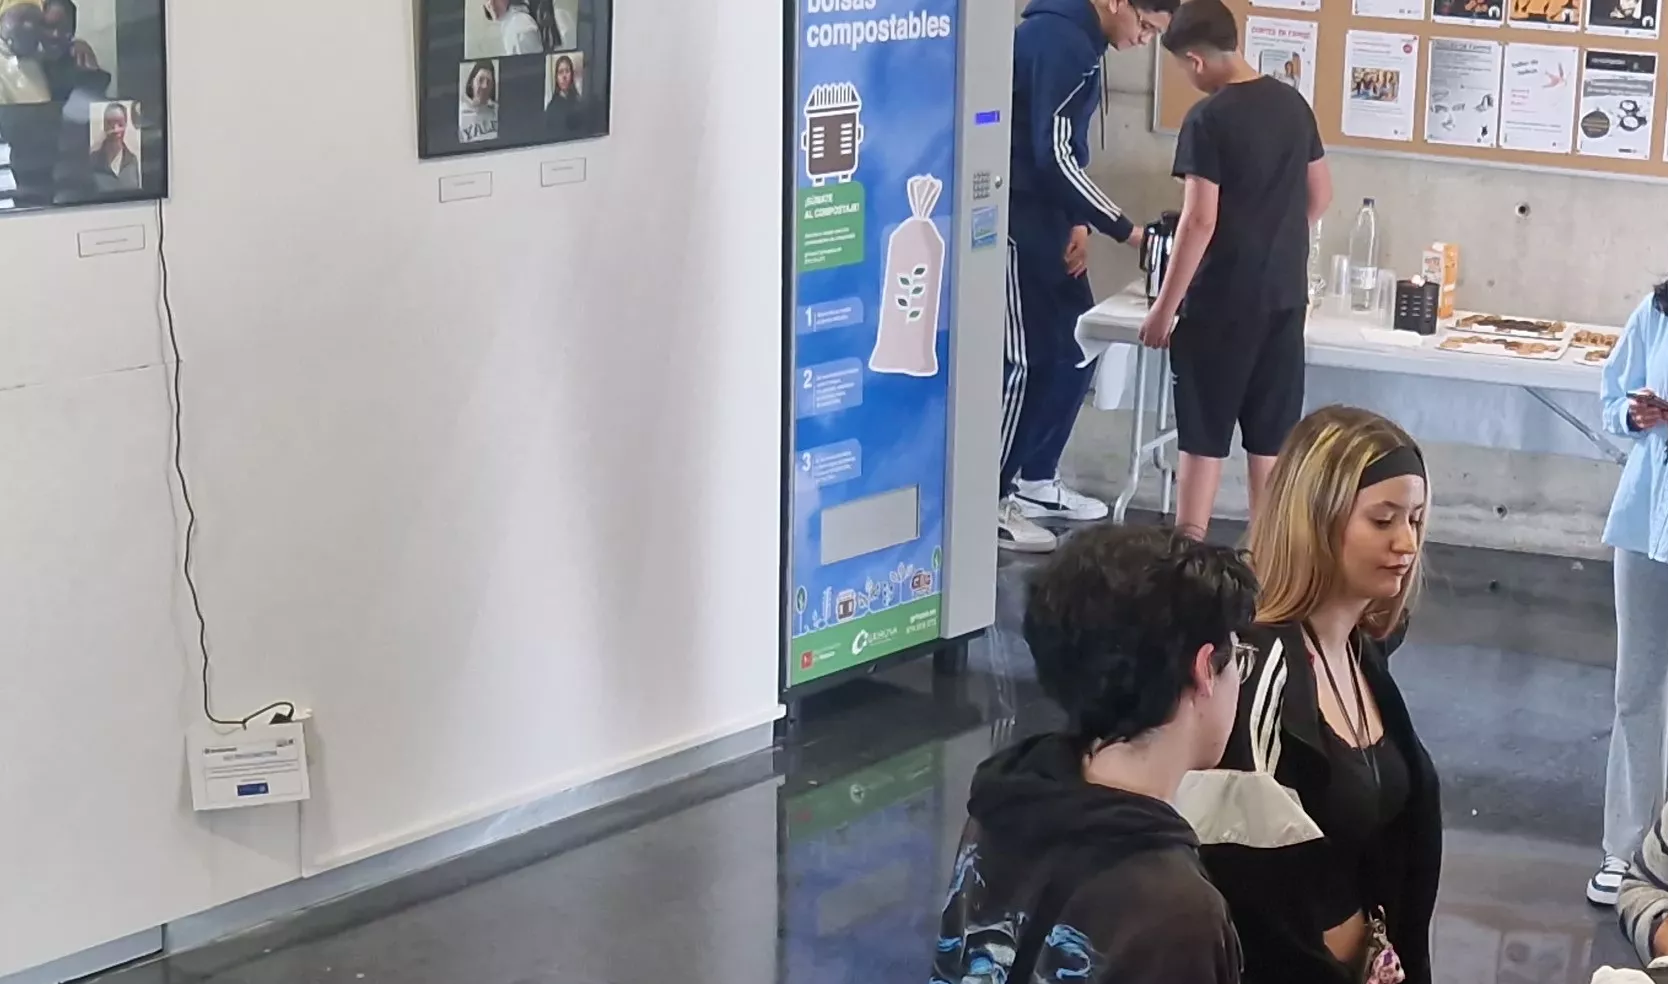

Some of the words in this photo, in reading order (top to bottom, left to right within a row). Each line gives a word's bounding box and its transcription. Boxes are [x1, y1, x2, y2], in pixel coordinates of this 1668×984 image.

[807, 10, 950, 51] compostables
[804, 206, 814, 220] AL
[805, 306, 812, 327] 1
[803, 369, 813, 388] 2
[801, 451, 812, 472] 3
